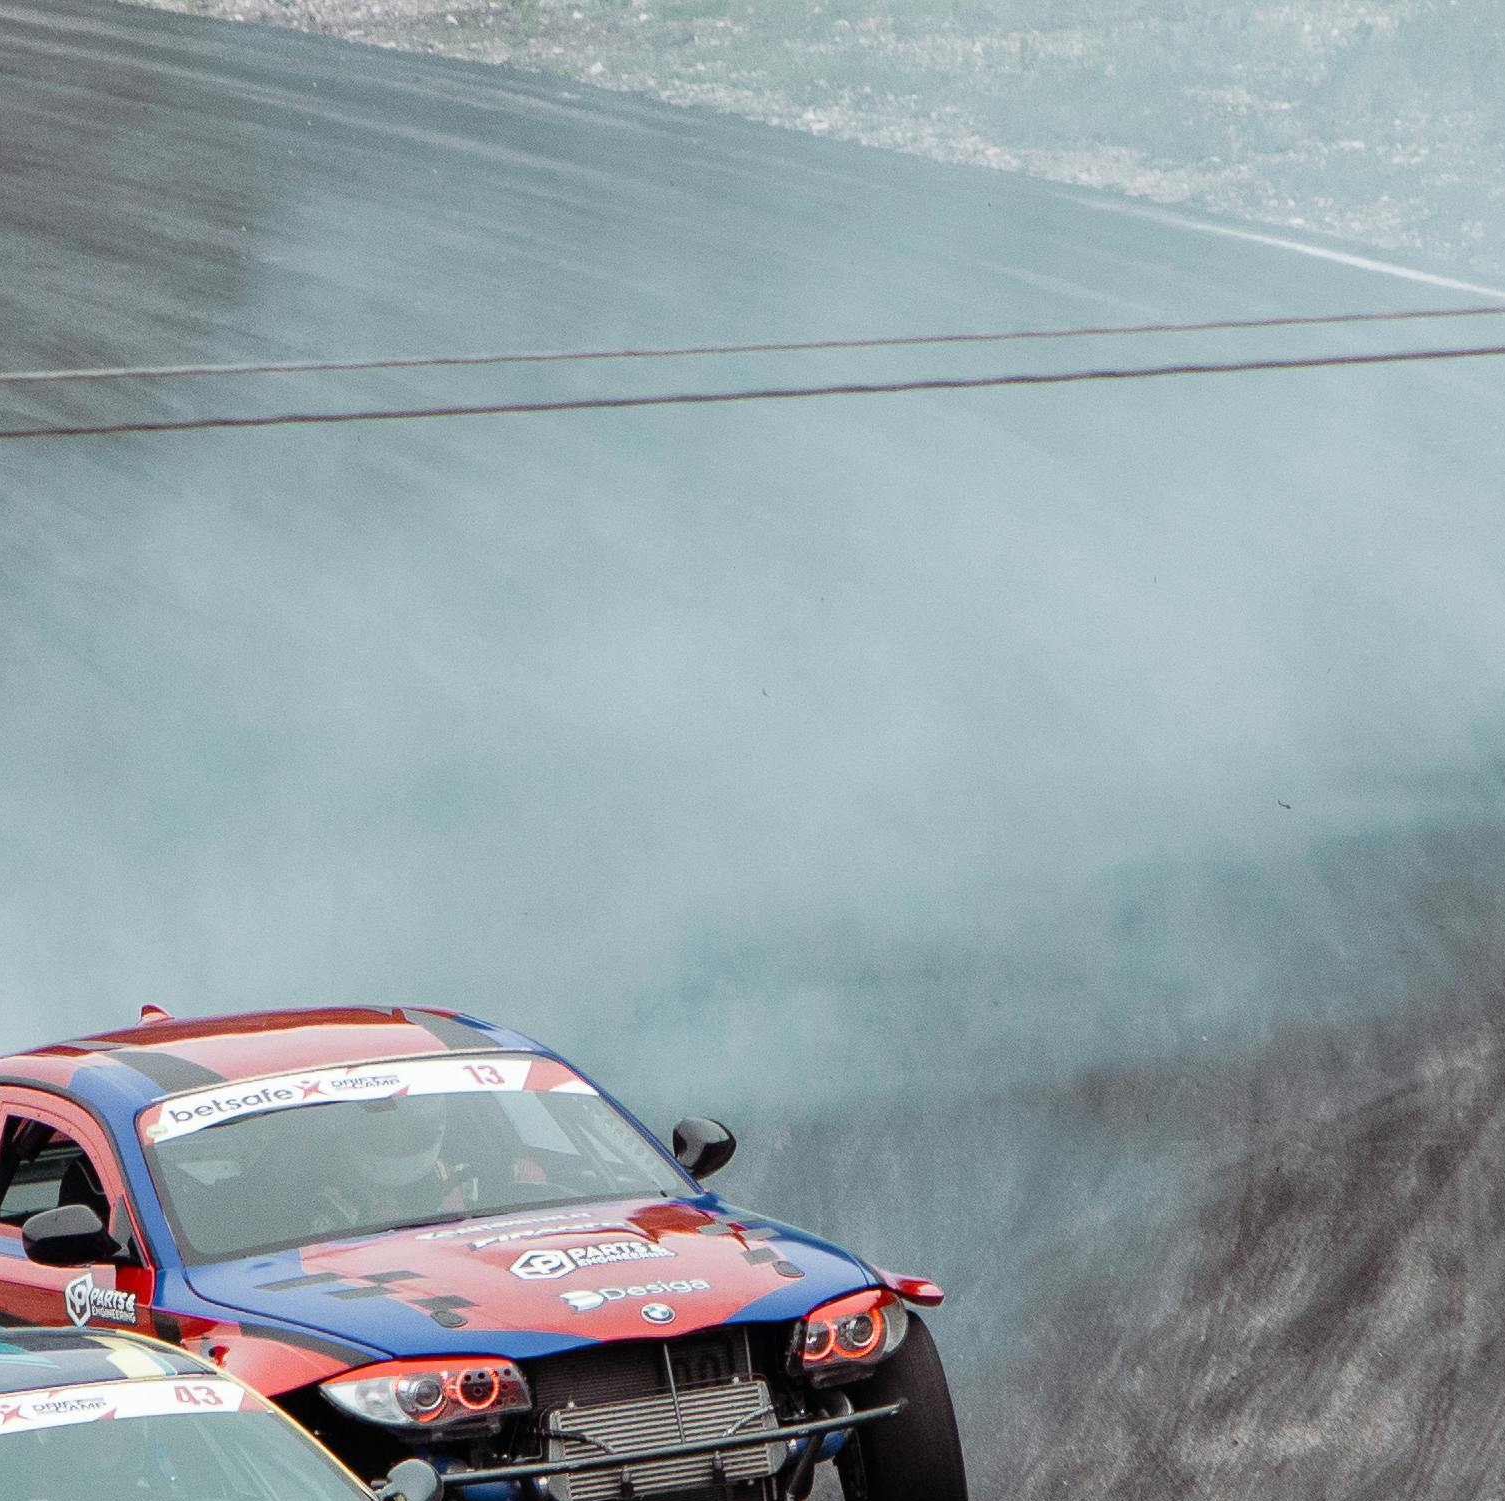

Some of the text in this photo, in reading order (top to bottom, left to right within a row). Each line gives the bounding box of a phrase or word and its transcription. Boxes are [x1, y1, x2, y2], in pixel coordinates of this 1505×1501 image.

[461, 1065, 505, 1085] 13
[169, 1086, 294, 1123] betsafe
[599, 1279, 710, 1300] Desiga
[175, 1385, 223, 1406] 43
